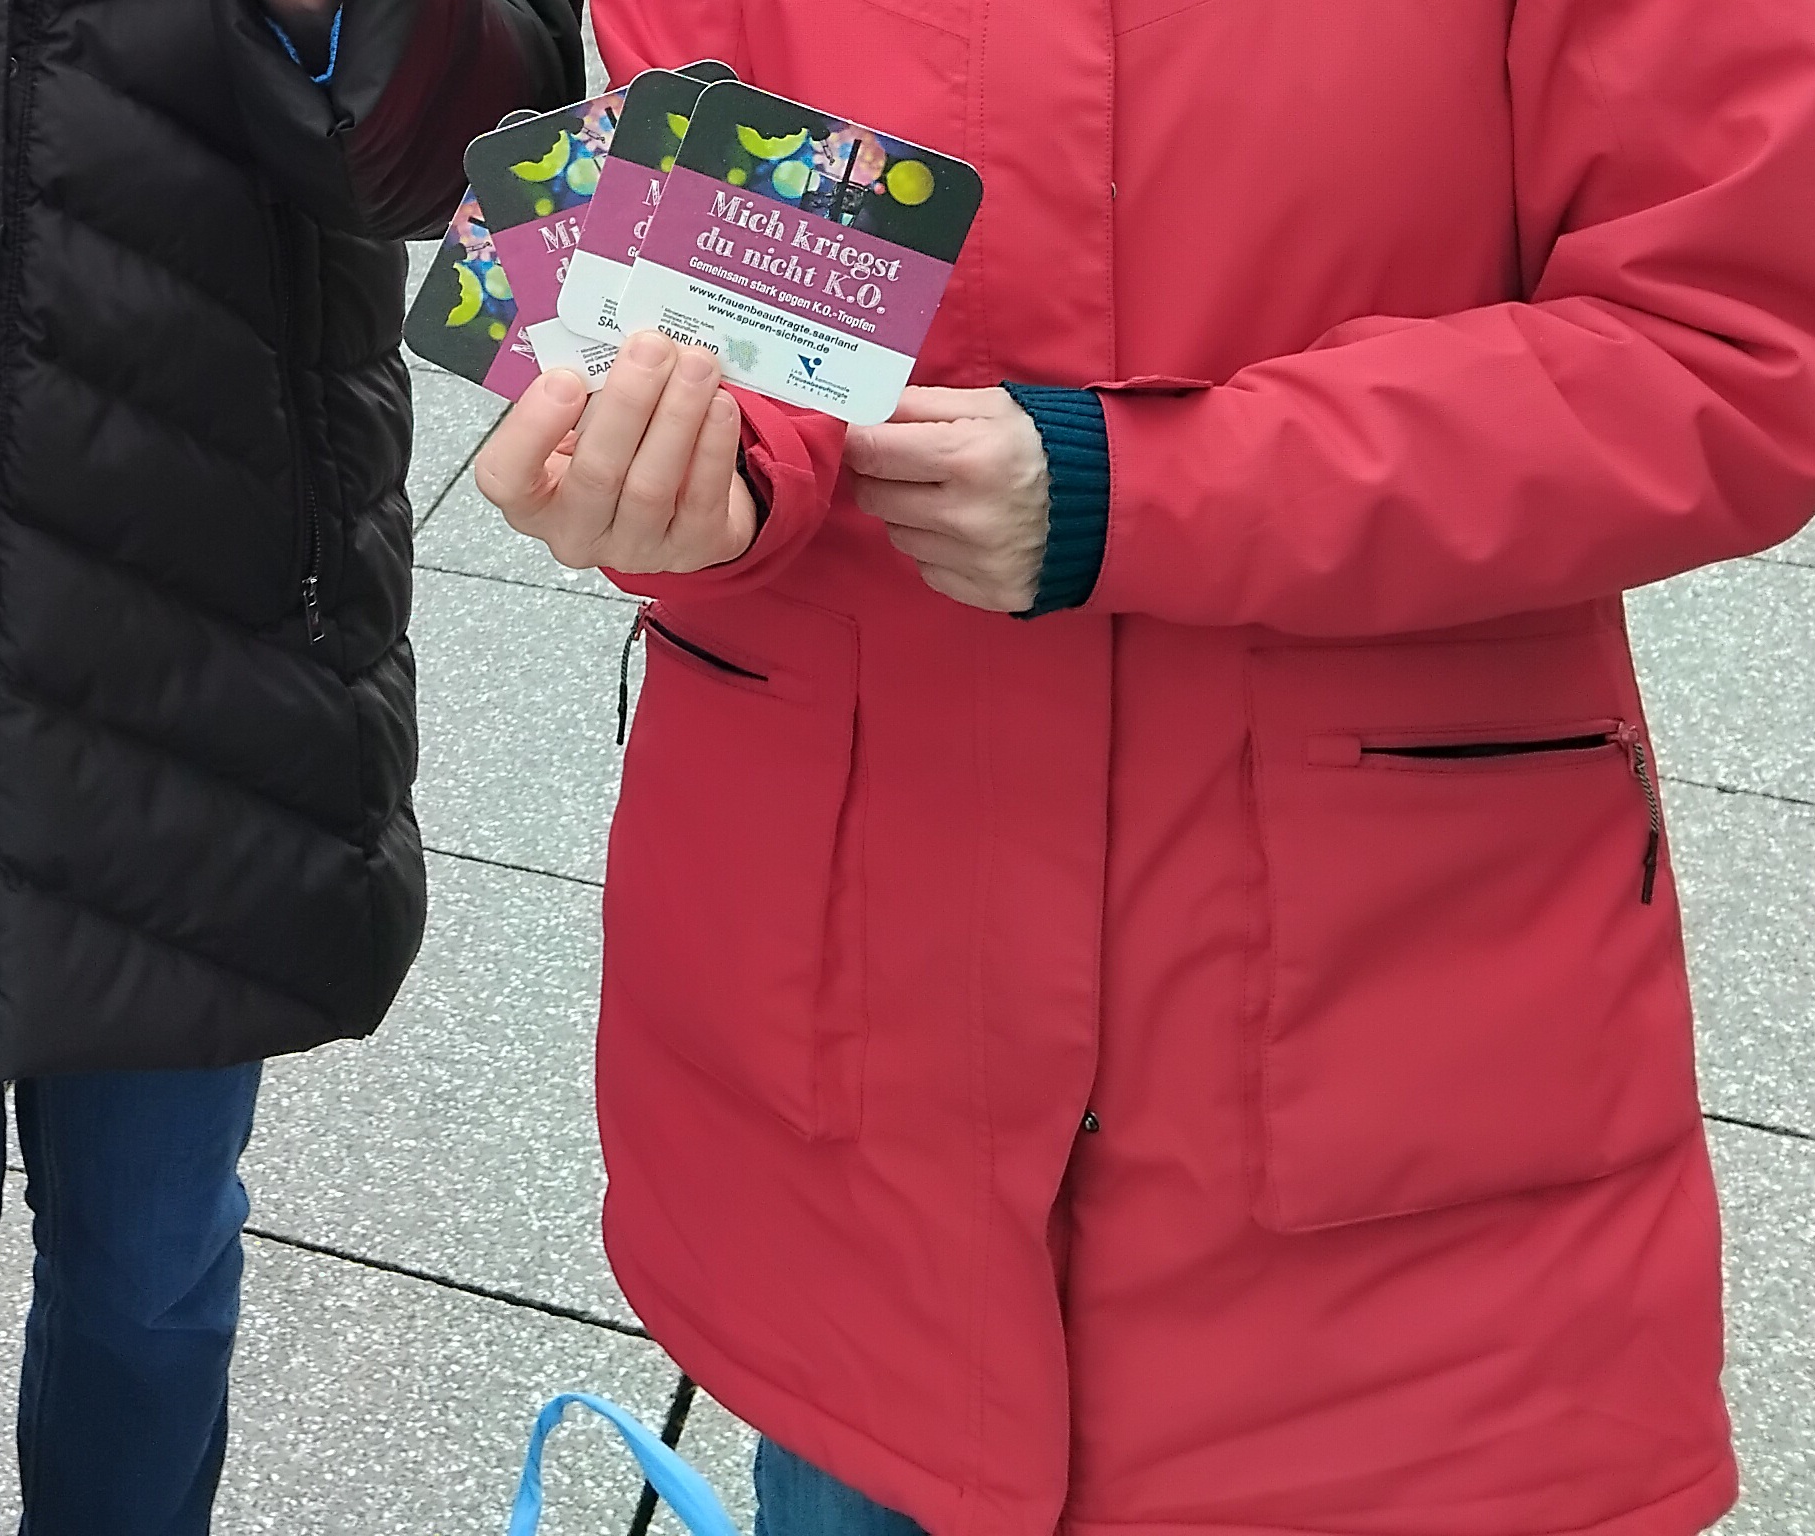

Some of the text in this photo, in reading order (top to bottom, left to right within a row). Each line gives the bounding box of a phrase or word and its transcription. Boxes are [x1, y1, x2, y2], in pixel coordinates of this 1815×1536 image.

[538, 217, 582, 254] Mi
[707, 190, 903, 282] Mich kriegst
[689, 256, 748, 287] Gemeinsam
[749, 279, 778, 298] stark
[778, 290, 810, 312] gegen
[696, 226, 886, 315] du nicht K.O.
[689, 283, 859, 353] www.frauenbeauftragte.saarland
[707, 302, 831, 355] www.spuren-sichern.de
